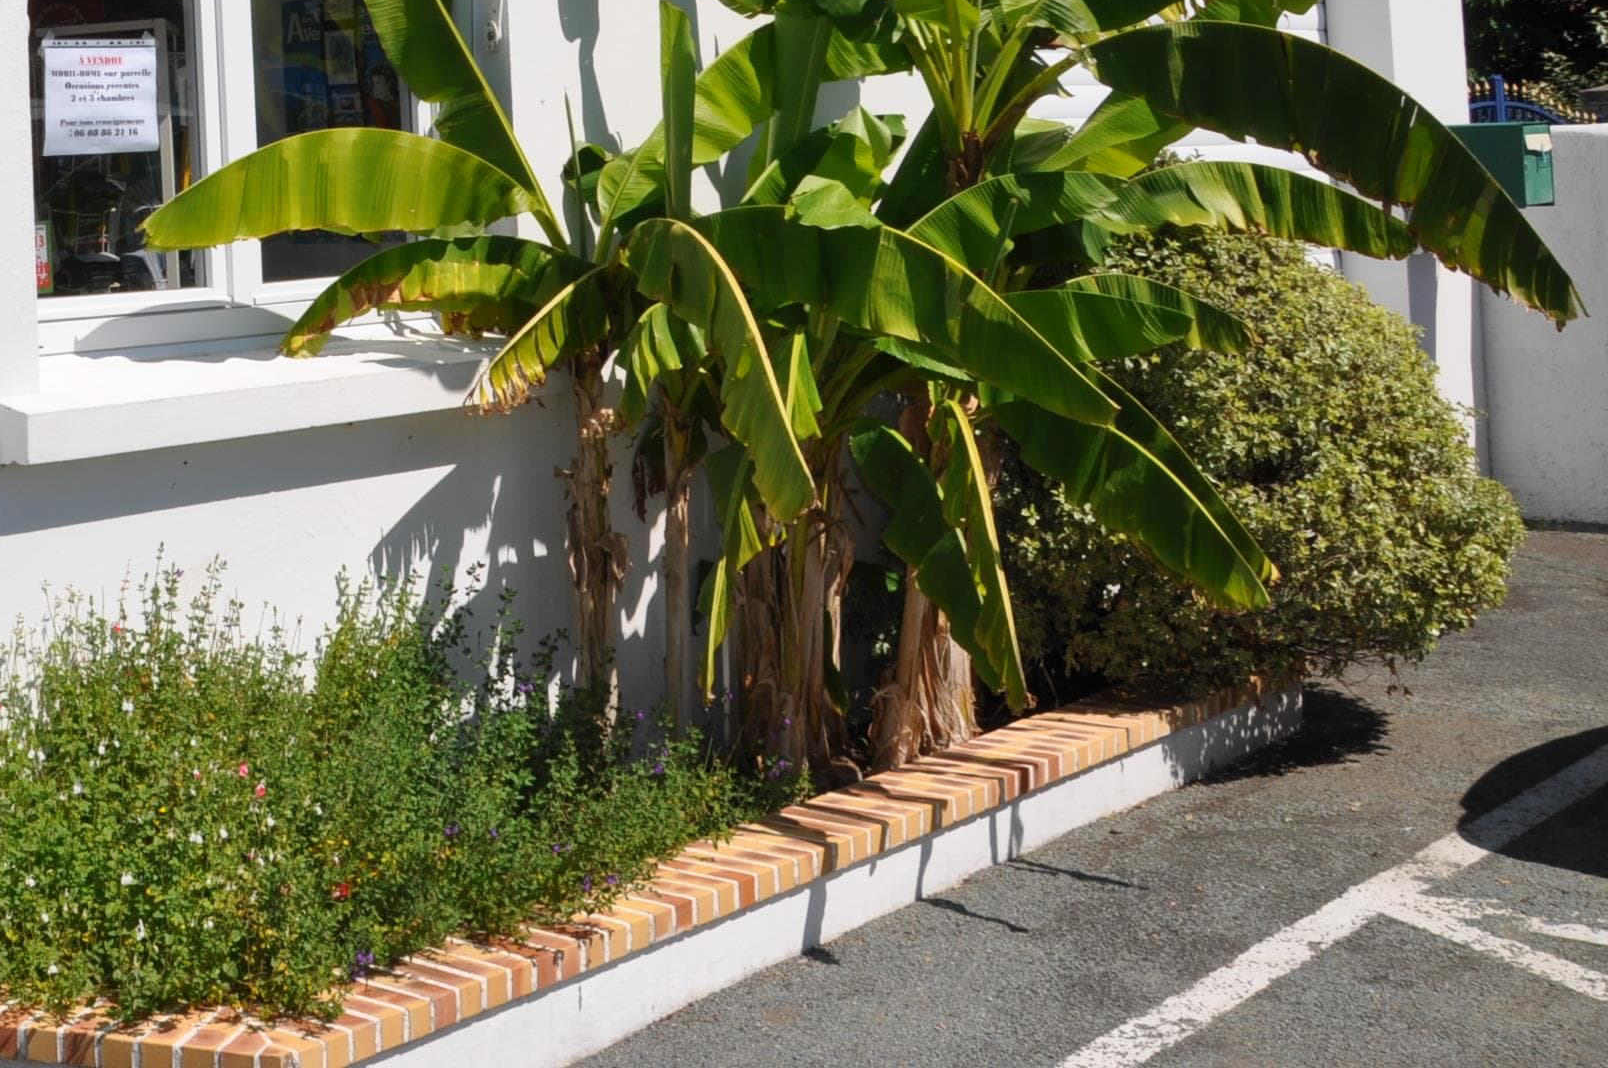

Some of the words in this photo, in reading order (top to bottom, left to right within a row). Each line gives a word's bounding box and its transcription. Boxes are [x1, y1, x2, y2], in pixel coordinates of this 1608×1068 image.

[87, 56, 124, 66] VENDRE
[65, 81, 104, 89] Occasions
[70, 94, 76, 102] 2
[96, 94, 135, 102] chambres
[73, 129, 85, 137] 06
